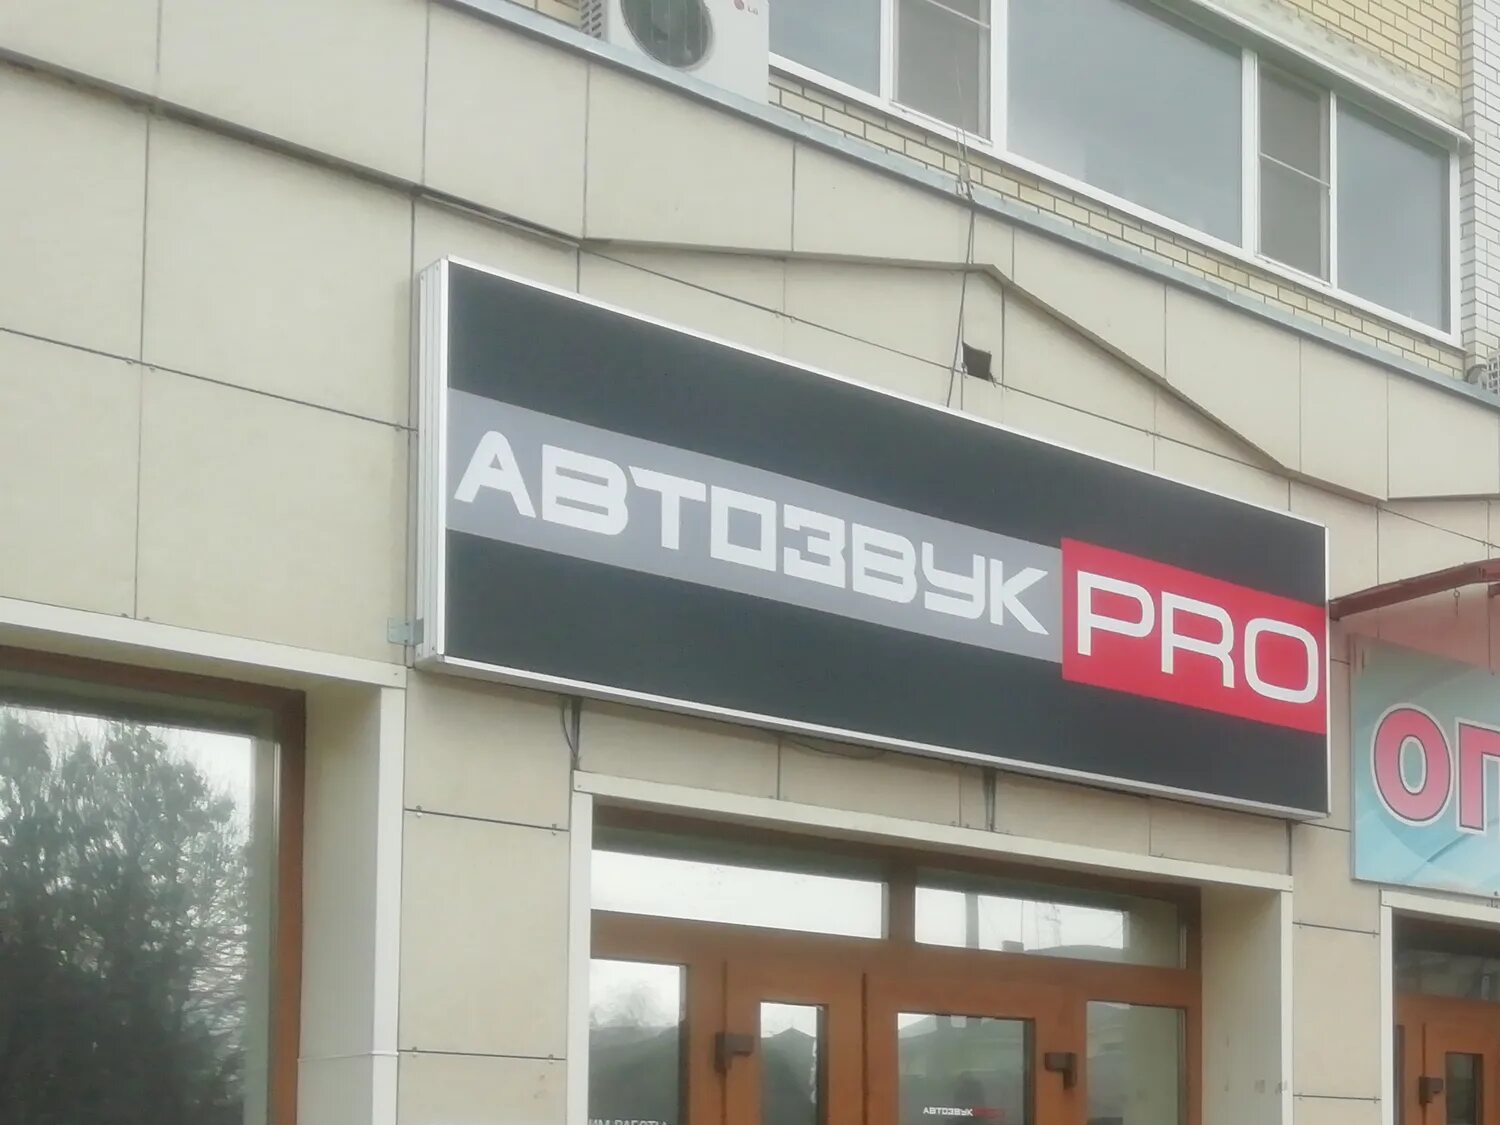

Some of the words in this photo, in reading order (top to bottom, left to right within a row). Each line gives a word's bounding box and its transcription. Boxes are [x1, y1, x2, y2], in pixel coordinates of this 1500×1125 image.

[454, 431, 1050, 636] АВТОЗВУК
[1077, 570, 1320, 704] PRO
[923, 1106, 974, 1117] АВТОЗВУК
